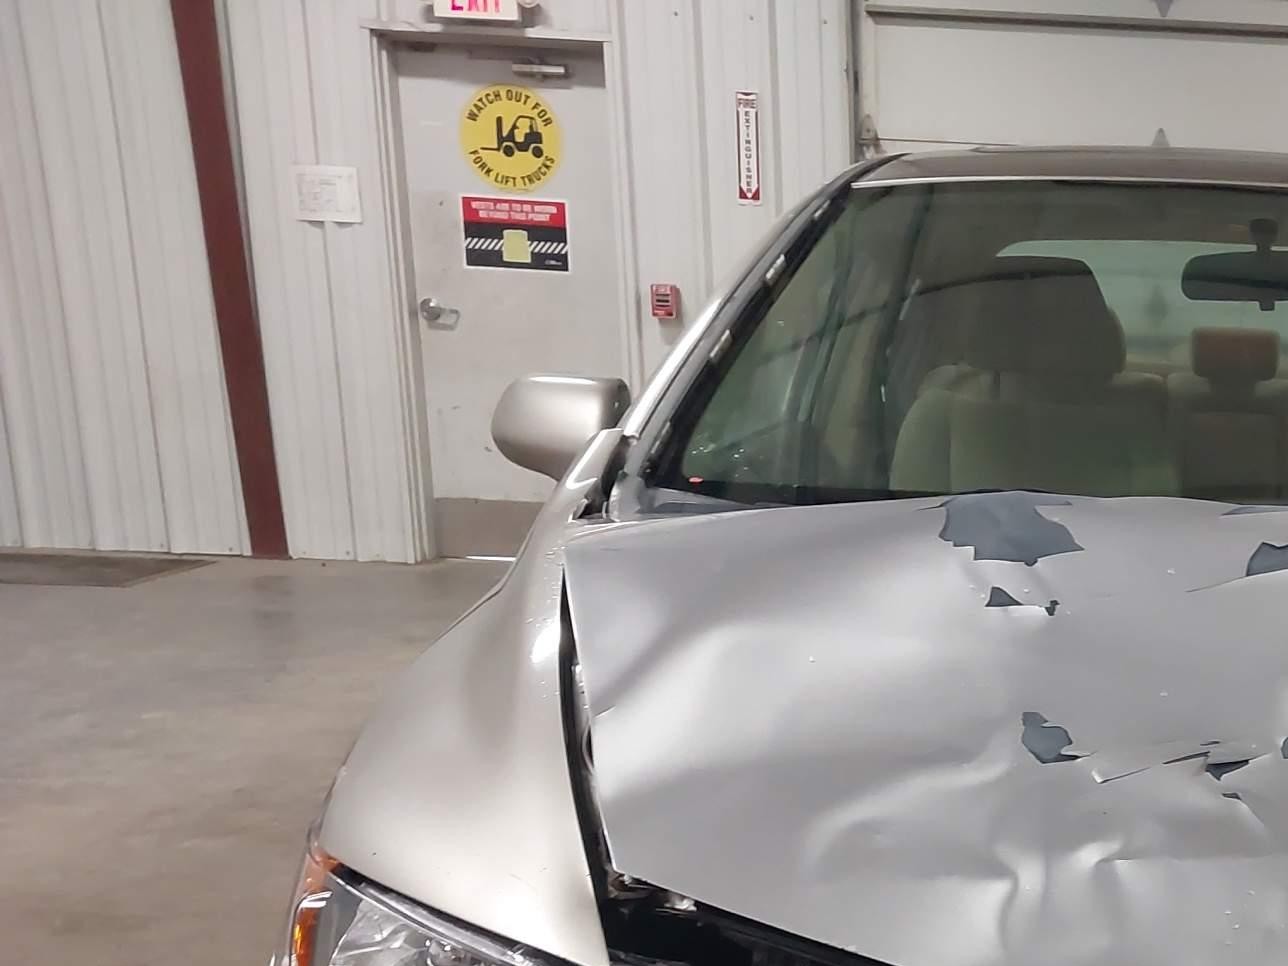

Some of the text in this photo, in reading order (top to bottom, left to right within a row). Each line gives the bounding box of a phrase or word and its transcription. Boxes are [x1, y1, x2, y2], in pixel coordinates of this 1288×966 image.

[466, 89, 553, 127] WATCH OUT FOR
[469, 149, 555, 187] FORK LIFT TRUCKS
[744, 110, 752, 193] EXTINGUISHER
